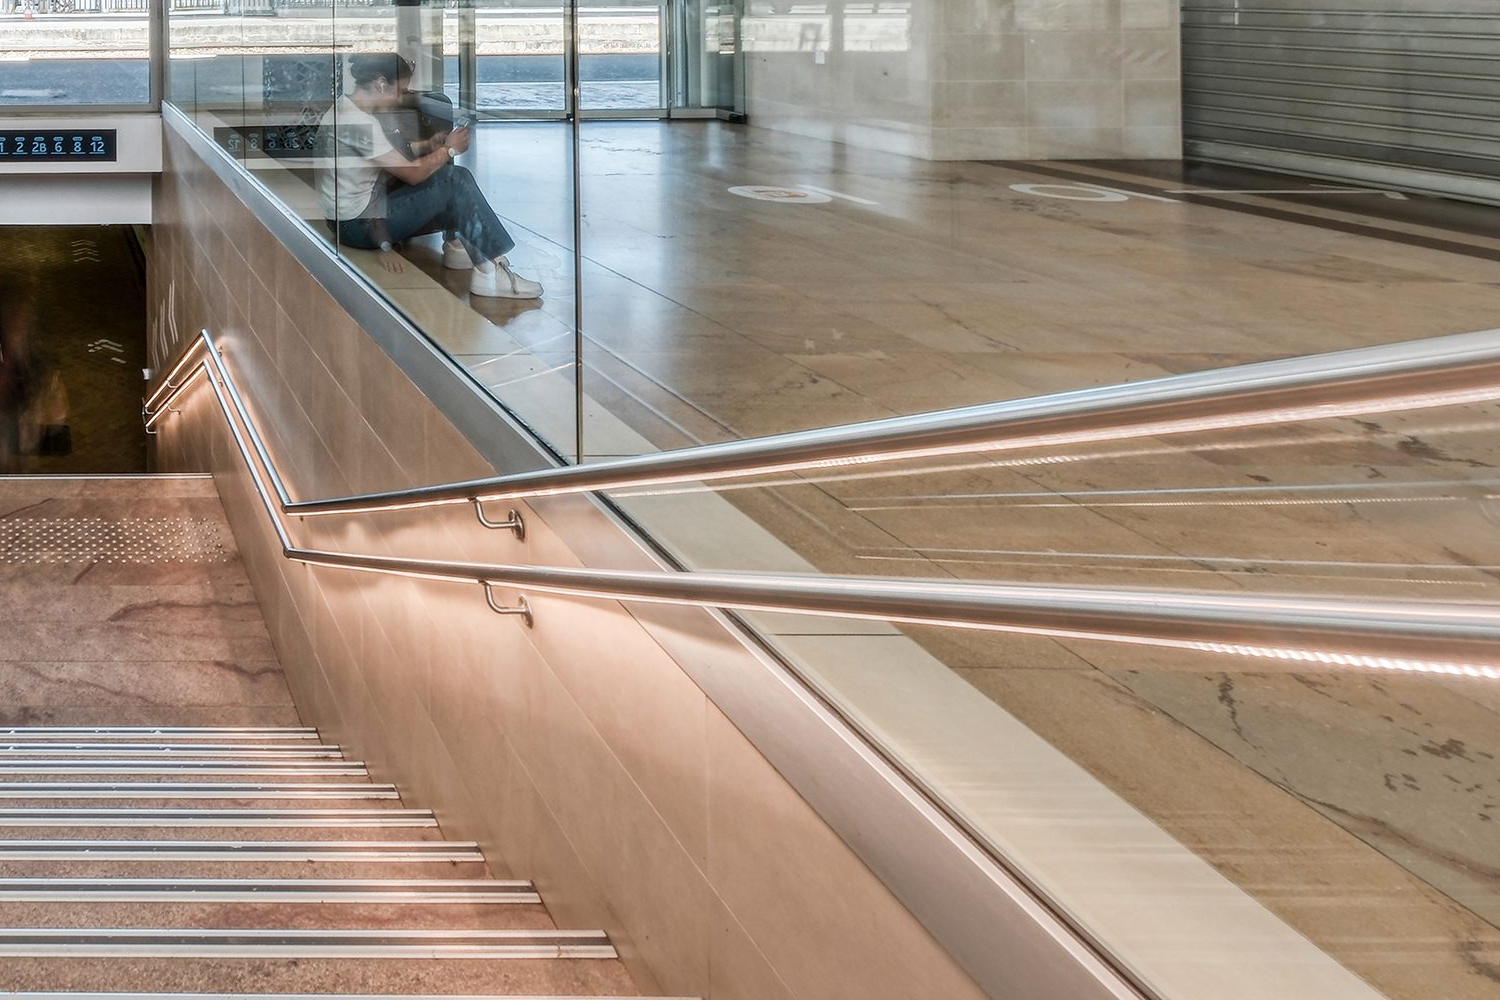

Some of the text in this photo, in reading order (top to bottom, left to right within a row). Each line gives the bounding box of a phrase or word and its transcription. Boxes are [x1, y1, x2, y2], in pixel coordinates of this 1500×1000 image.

[16, 142, 24, 152] 2
[31, 142, 47, 152] 2B
[54, 142, 63, 152] 6
[73, 142, 82, 152] 8
[90, 142, 105, 152] 12
